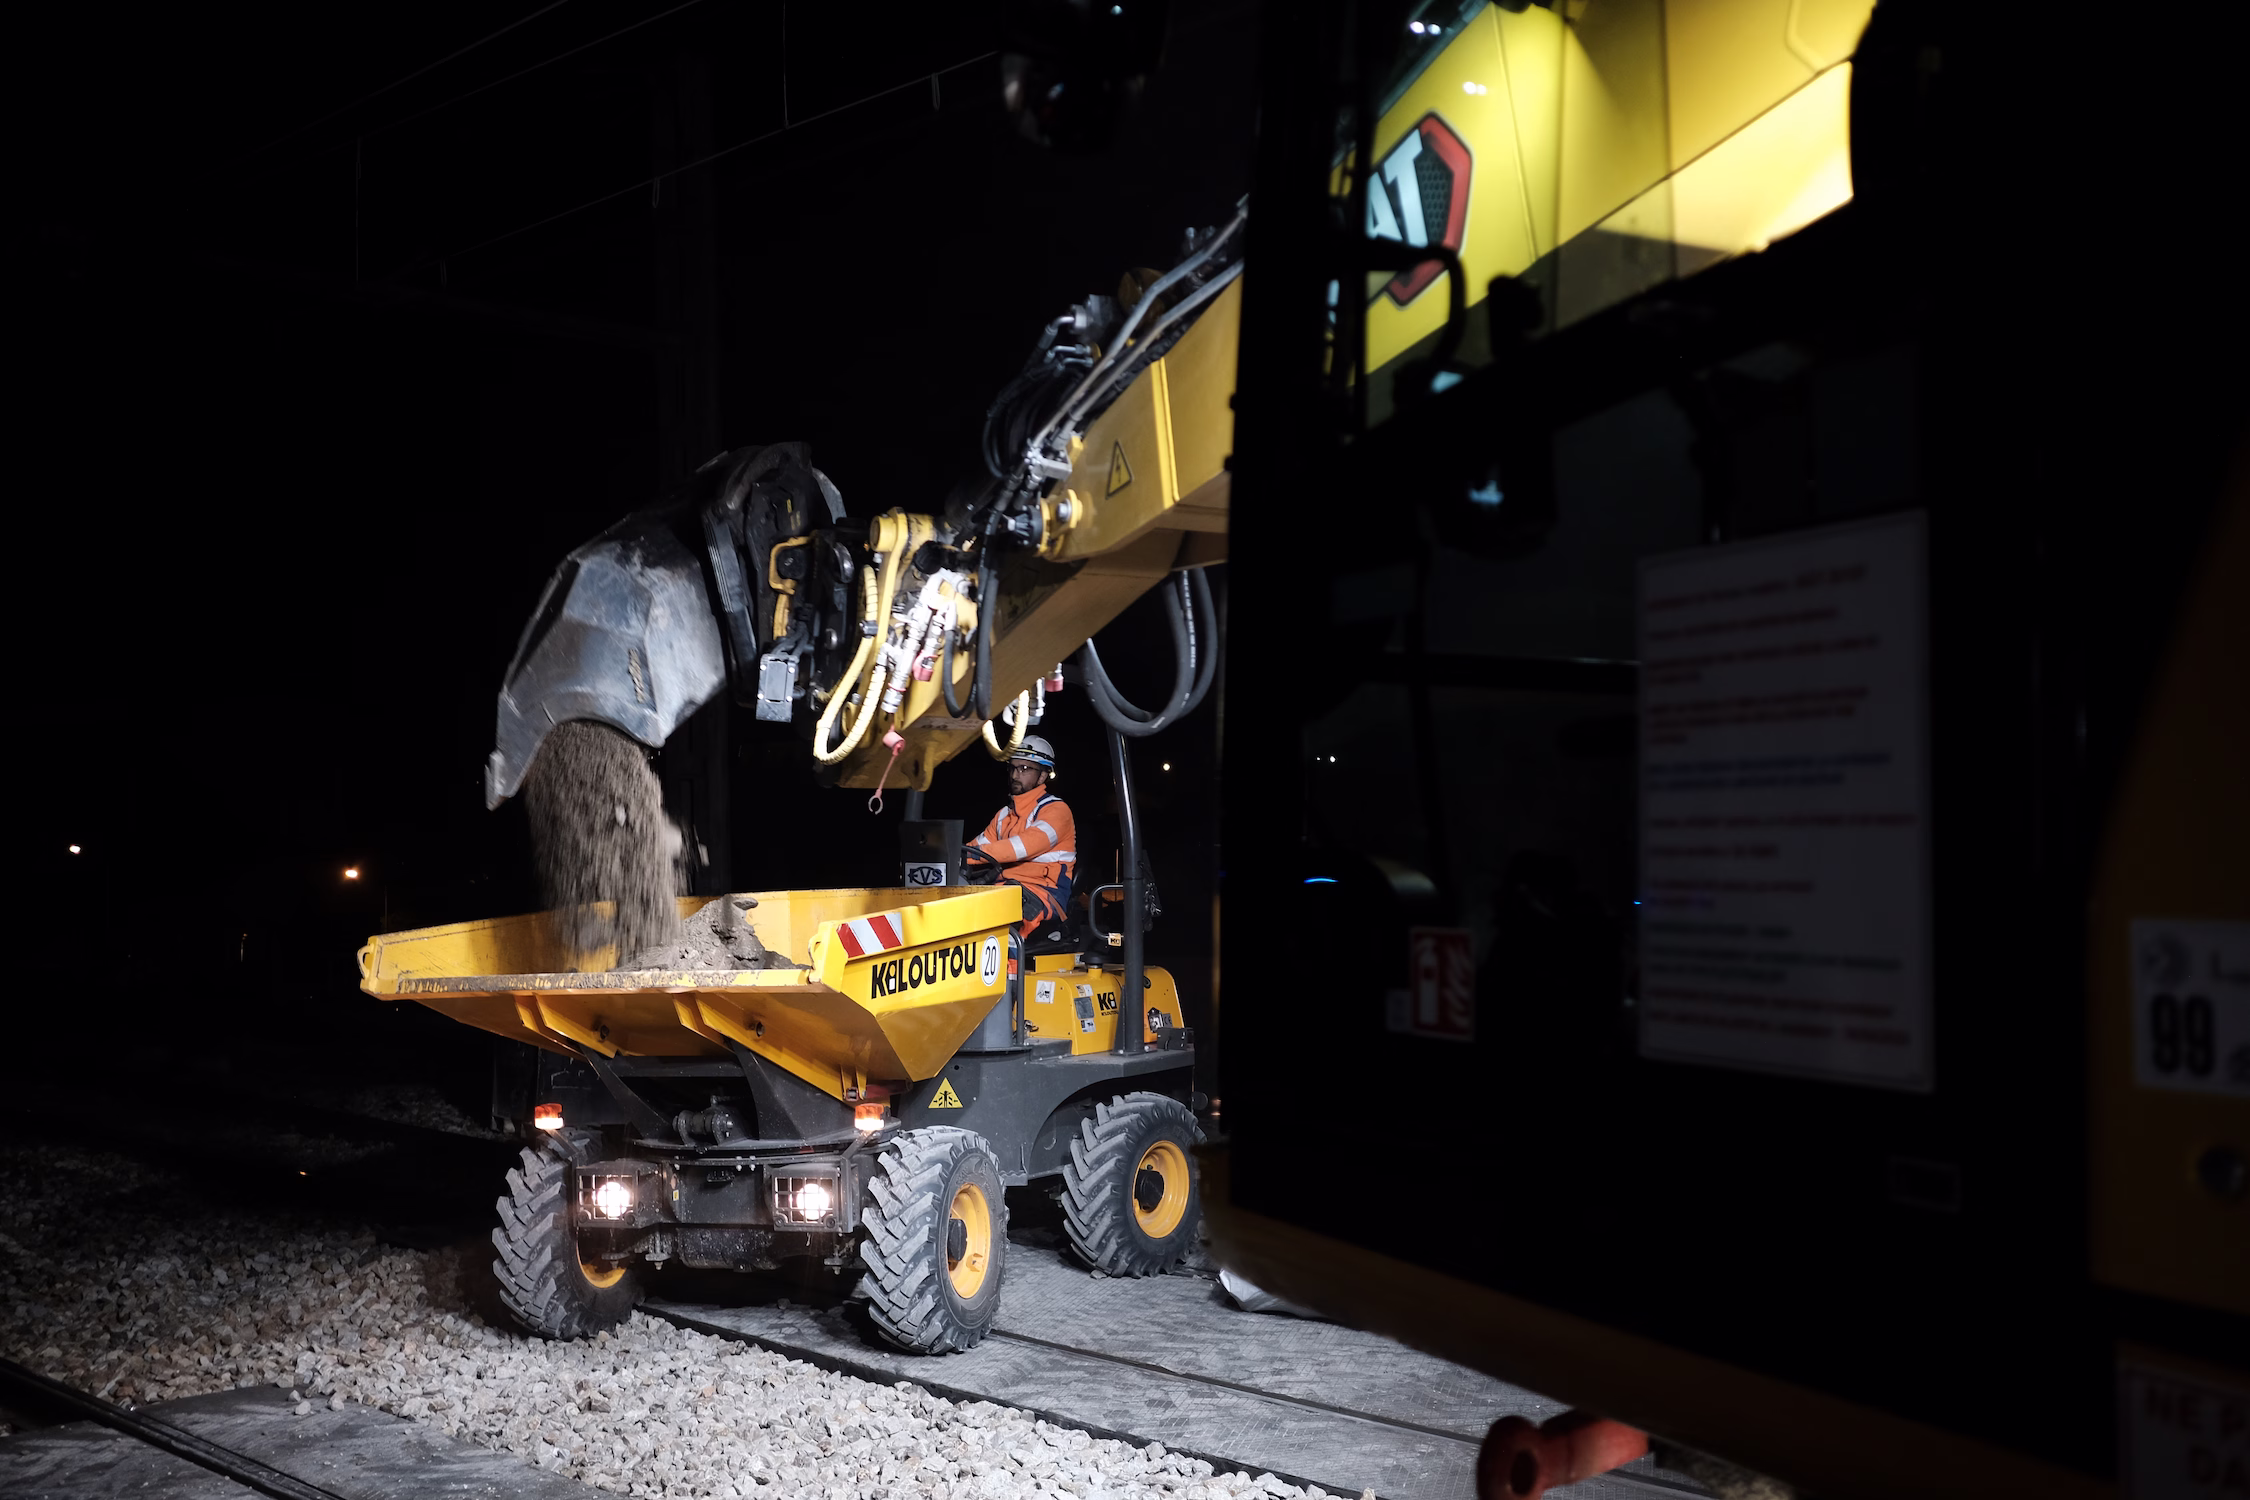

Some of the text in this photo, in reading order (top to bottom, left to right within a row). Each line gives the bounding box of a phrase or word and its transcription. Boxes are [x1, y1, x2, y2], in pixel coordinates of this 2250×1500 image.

[1364, 127, 1429, 250] AT
[984, 945, 997, 977] 20
[2145, 1384, 2204, 1434] NE
